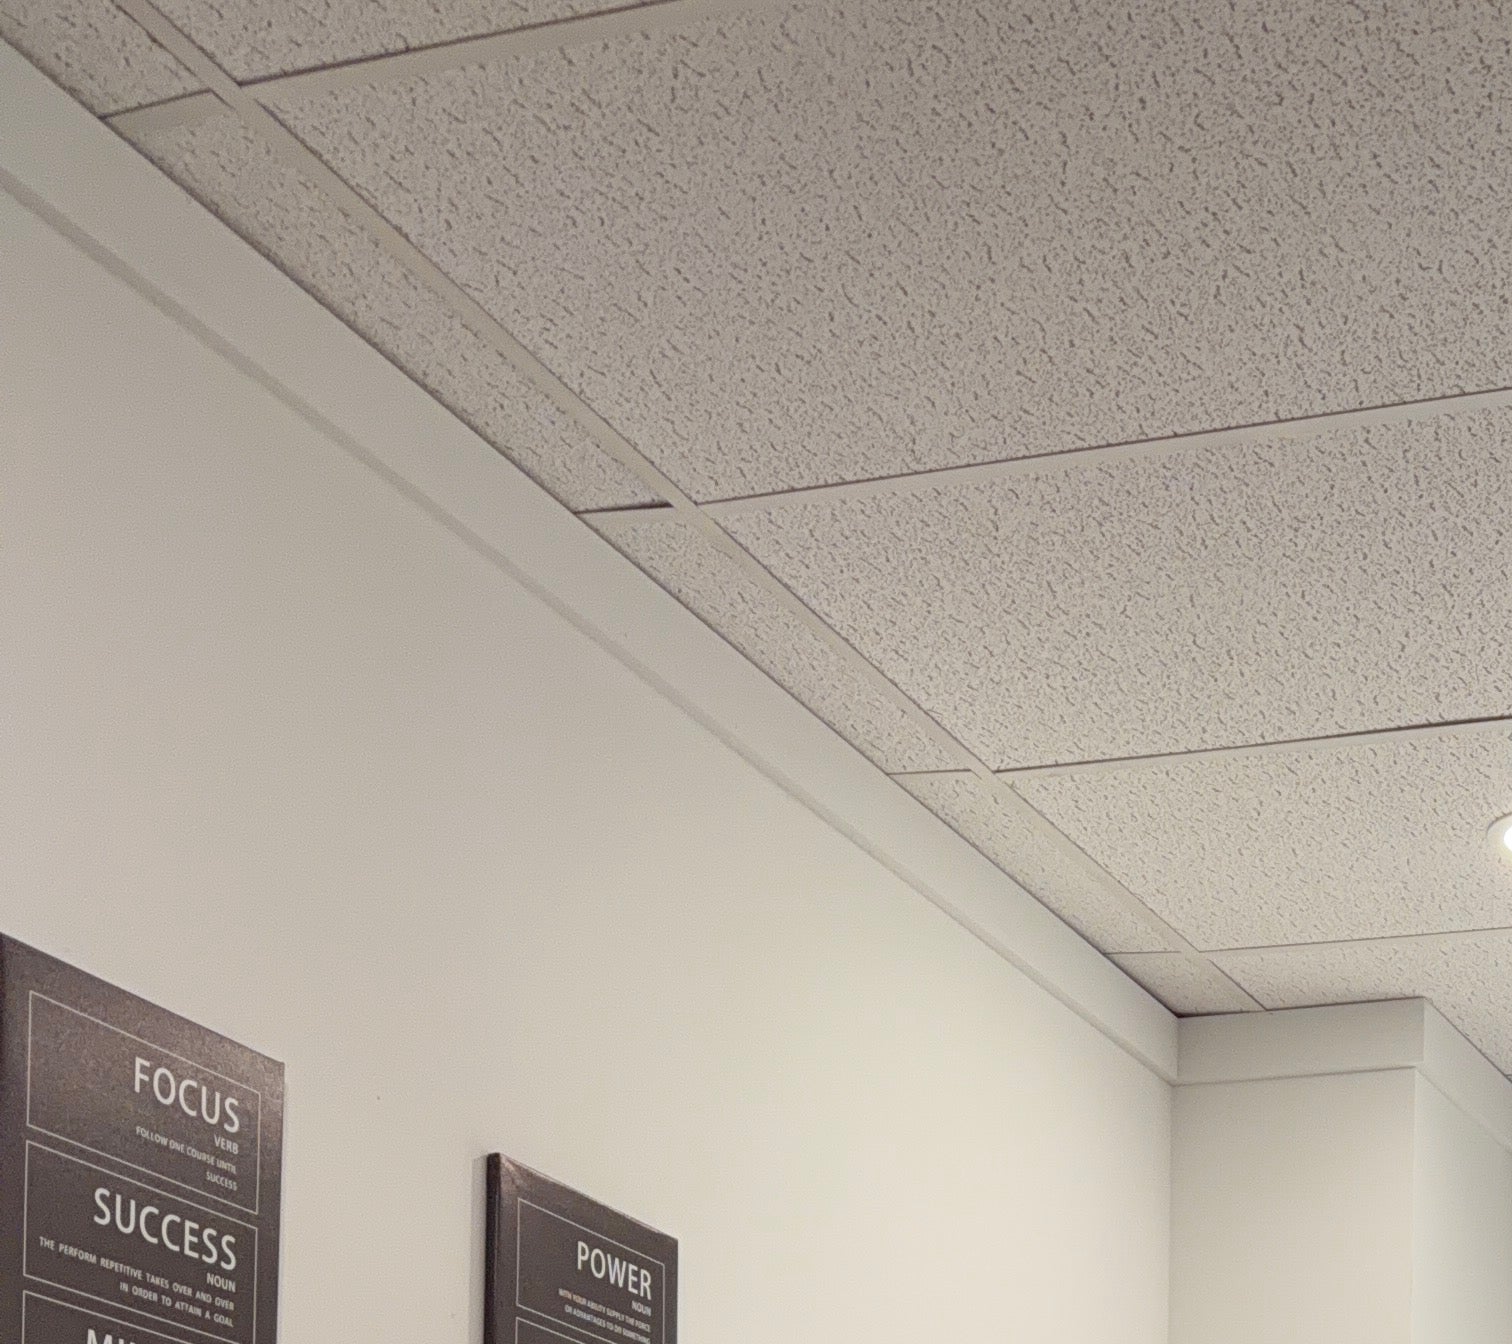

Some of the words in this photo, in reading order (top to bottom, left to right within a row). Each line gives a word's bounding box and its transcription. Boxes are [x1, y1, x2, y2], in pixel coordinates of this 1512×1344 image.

[134, 1056, 240, 1133] FOCUS
[136, 1126, 168, 1147] FOLLOW
[169, 1138, 185, 1153] ONE
[186, 1146, 215, 1166] COURSE
[216, 1157, 236, 1174] UNTIL
[214, 1134, 239, 1154] VERB
[206, 1171, 237, 1191] SUCCESS
[93, 1187, 236, 1270] SUCCESS
[39, 1236, 54, 1251] THE
[58, 1243, 97, 1264] PERFORM
[100, 1257, 143, 1281] REPETITIVE
[146, 1272, 169, 1289] TAKES
[172, 1281, 192, 1297] OVER
[196, 1290, 212, 1305] AND
[214, 1297, 234, 1311] OVER
[206, 1272, 236, 1293] NOUN
[577, 1240, 651, 1300] POWER
[119, 1282, 128, 1292] IN
[132, 1286, 158, 1302] ORDER
[161, 1295, 172, 1307] TO
[174, 1299, 202, 1317] ATTAIN
[204, 1308, 211, 1319] A
[213, 1312, 234, 1328] GOAL
[631, 1300, 651, 1317] NOUN
